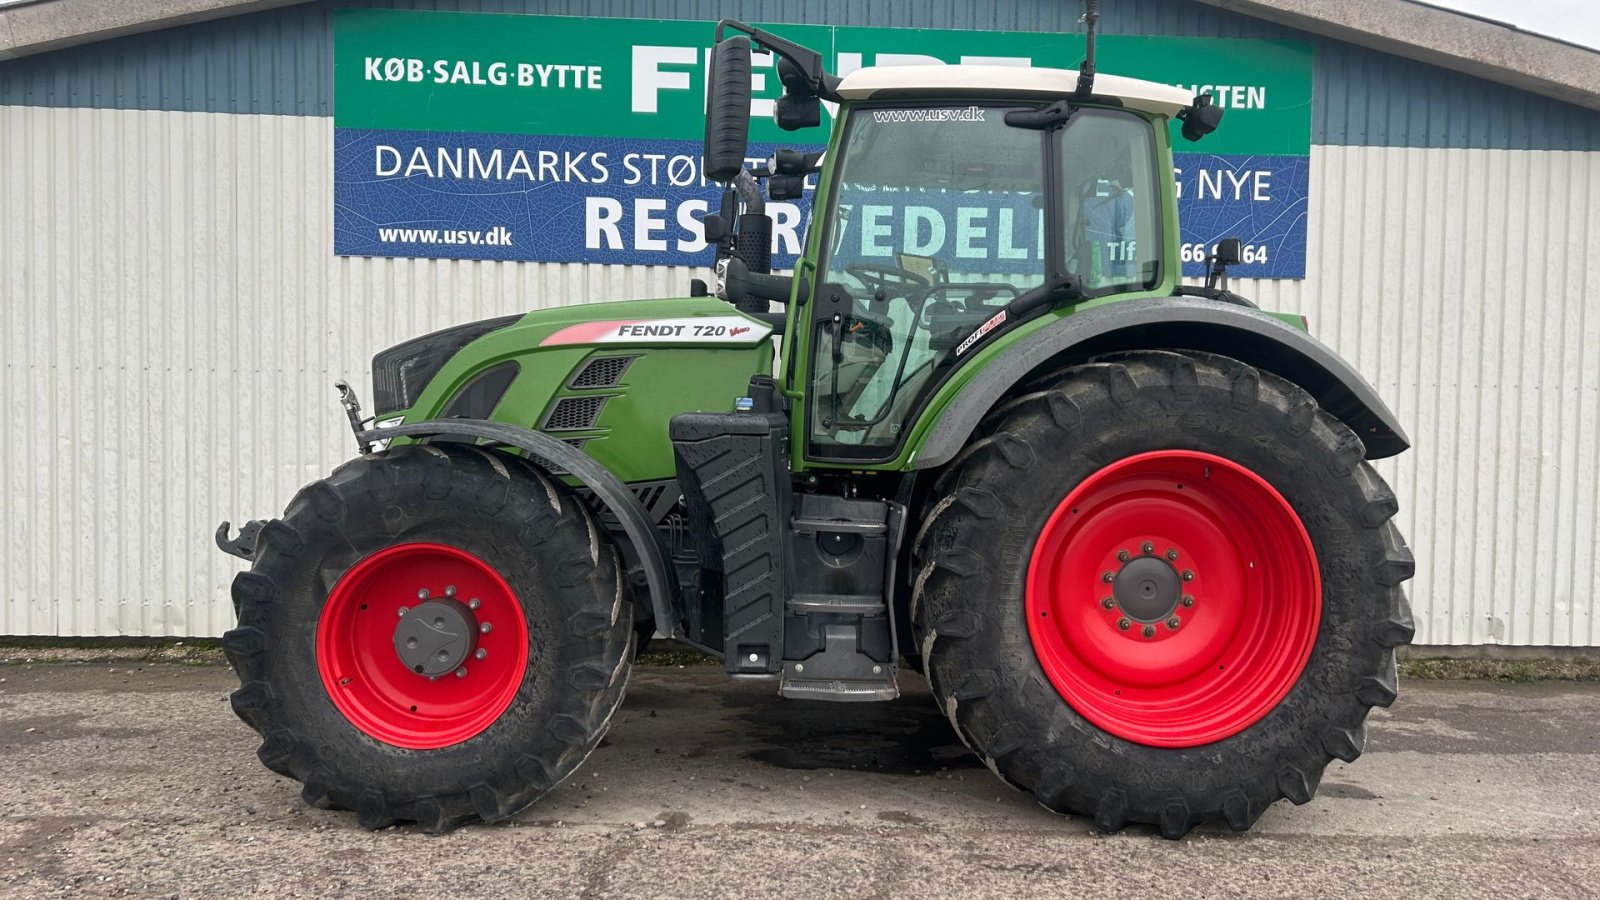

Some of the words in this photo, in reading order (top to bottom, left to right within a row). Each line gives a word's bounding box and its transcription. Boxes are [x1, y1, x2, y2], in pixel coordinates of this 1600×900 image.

[873, 106, 985, 123] www.usv.dk
[375, 145, 609, 184] DANMARKS
[1198, 169, 1272, 201] NYE
[379, 227, 512, 246] www.usv.dk
[1242, 245, 1267, 264] 64
[618, 325, 685, 337] FENDT
[693, 325, 726, 337] 720
